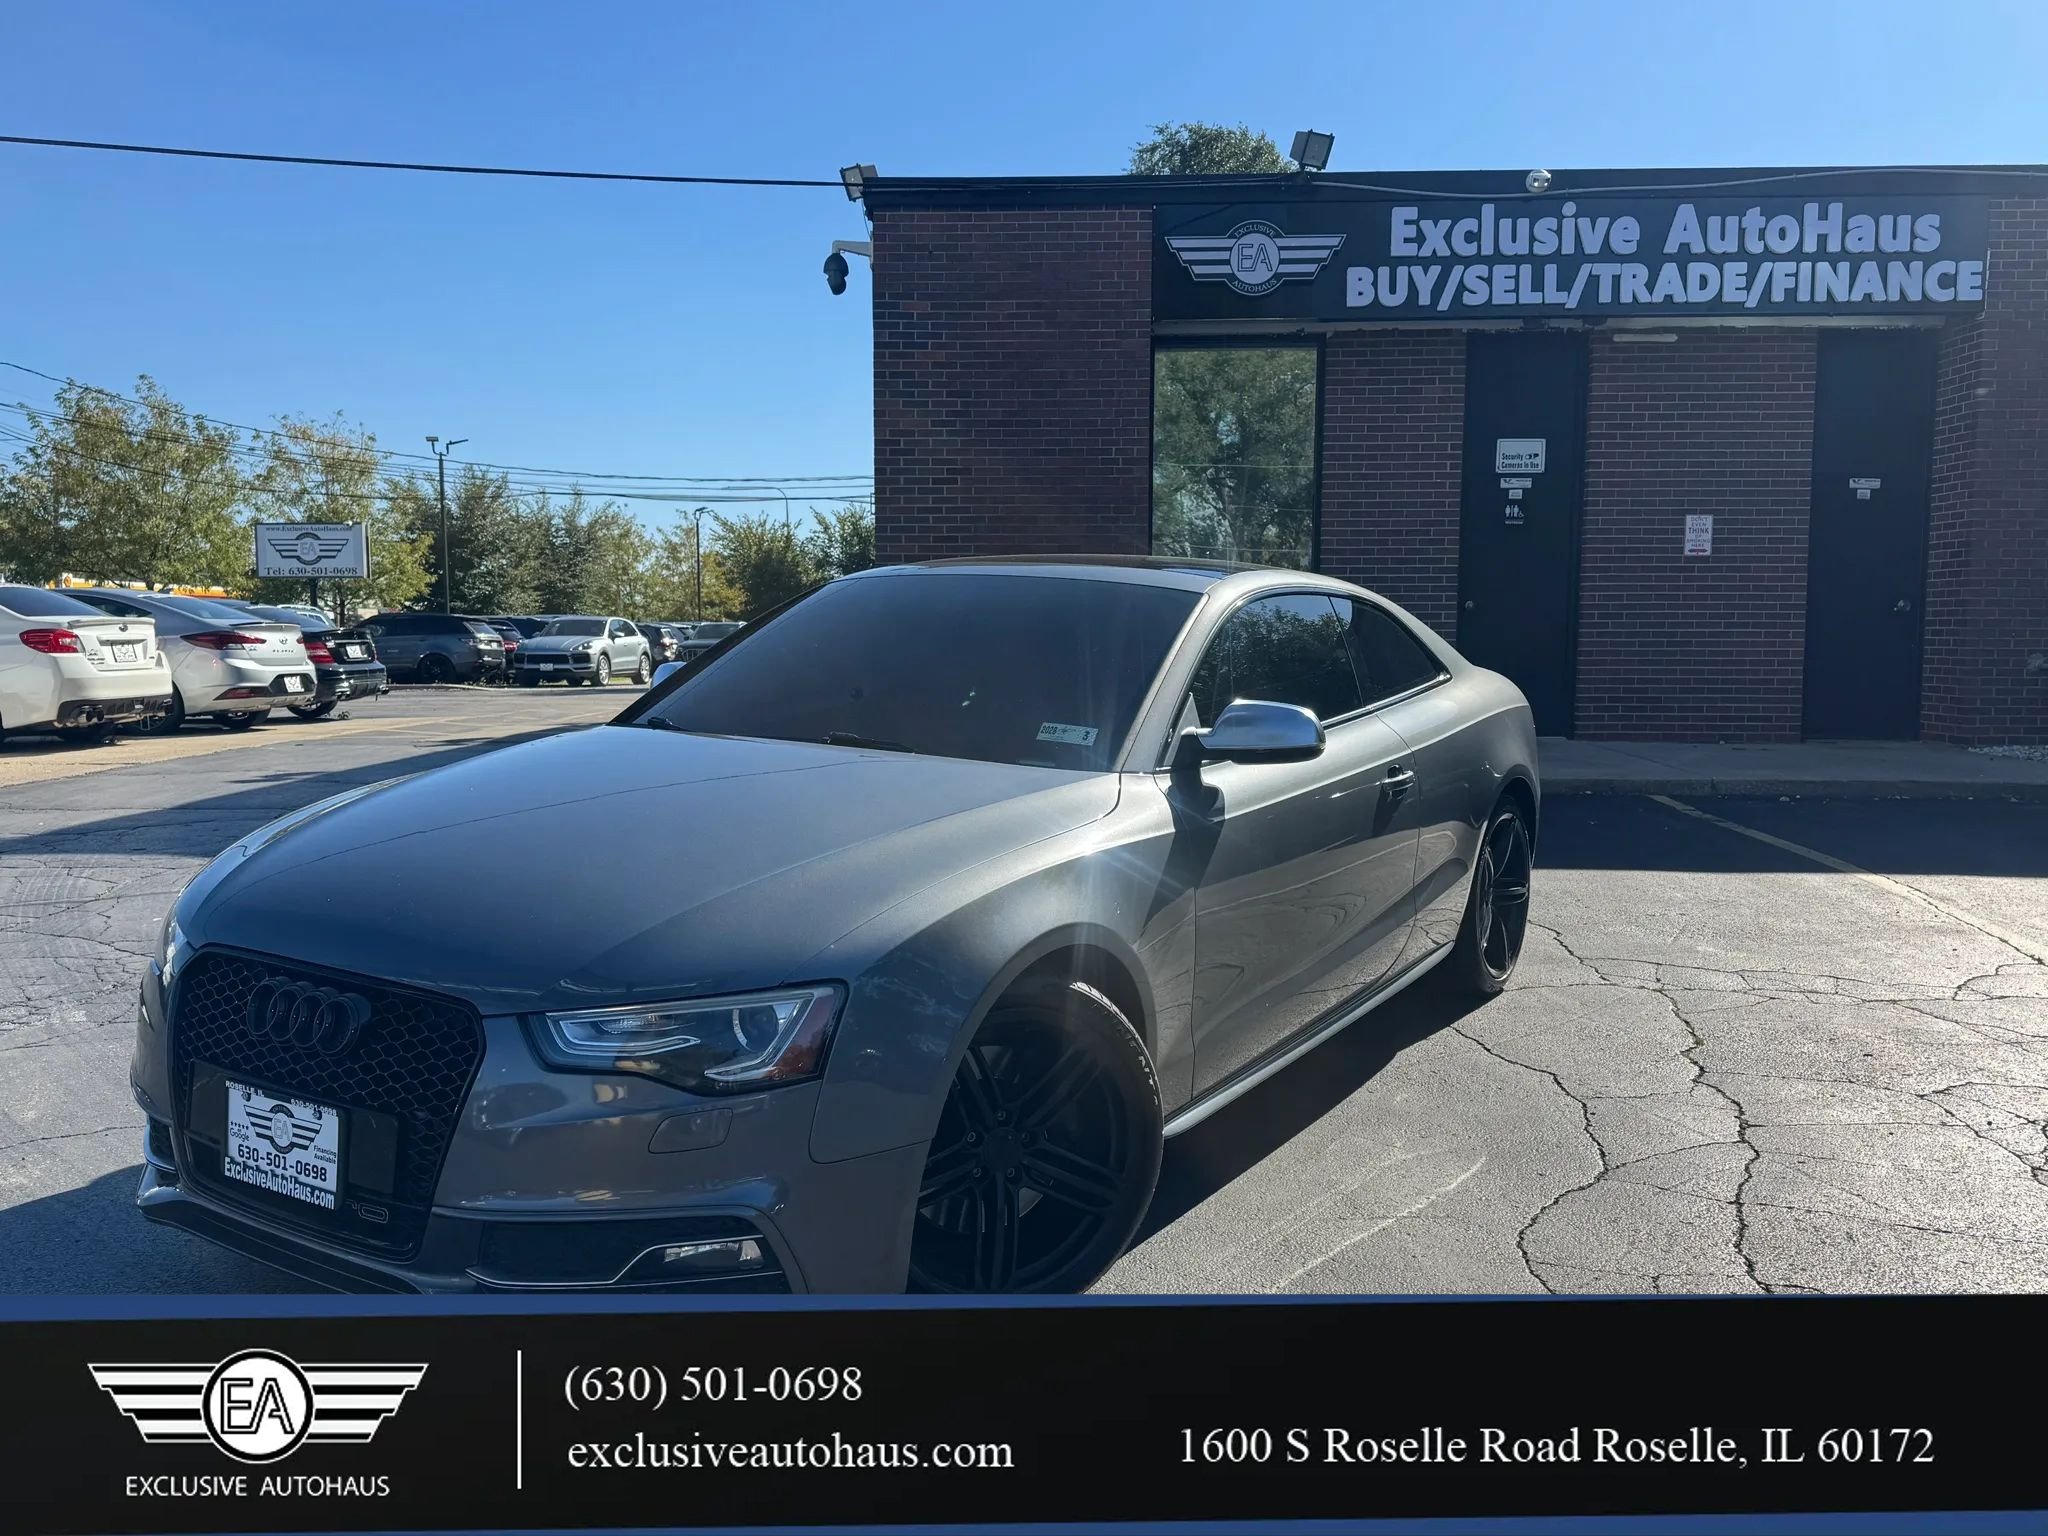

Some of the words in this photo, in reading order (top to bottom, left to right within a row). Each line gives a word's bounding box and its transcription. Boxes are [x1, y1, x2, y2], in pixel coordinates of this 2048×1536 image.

[1234, 224, 1277, 238] EXCLUSIVE
[1390, 201, 1641, 257] Exclusive
[1662, 202, 1942, 254] AutoHaus
[1237, 243, 1273, 272] EA
[1232, 279, 1278, 292] AUTOHAUS
[1345, 259, 1984, 311] BUY/SELL/TRADE/FINANCE
[1501, 453, 1523, 461] Security
[1501, 461, 1523, 469] Cameras
[264, 567, 285, 576] Tel:
[288, 567, 358, 576] 630-501-0698
[229, 1127, 250, 1142] Google
[313, 1145, 337, 1158] Financing
[313, 1153, 336, 1164] Available
[238, 1144, 327, 1182] 630-501-0698
[224, 1156, 335, 1210] ExclusiveAutoHaus.com
